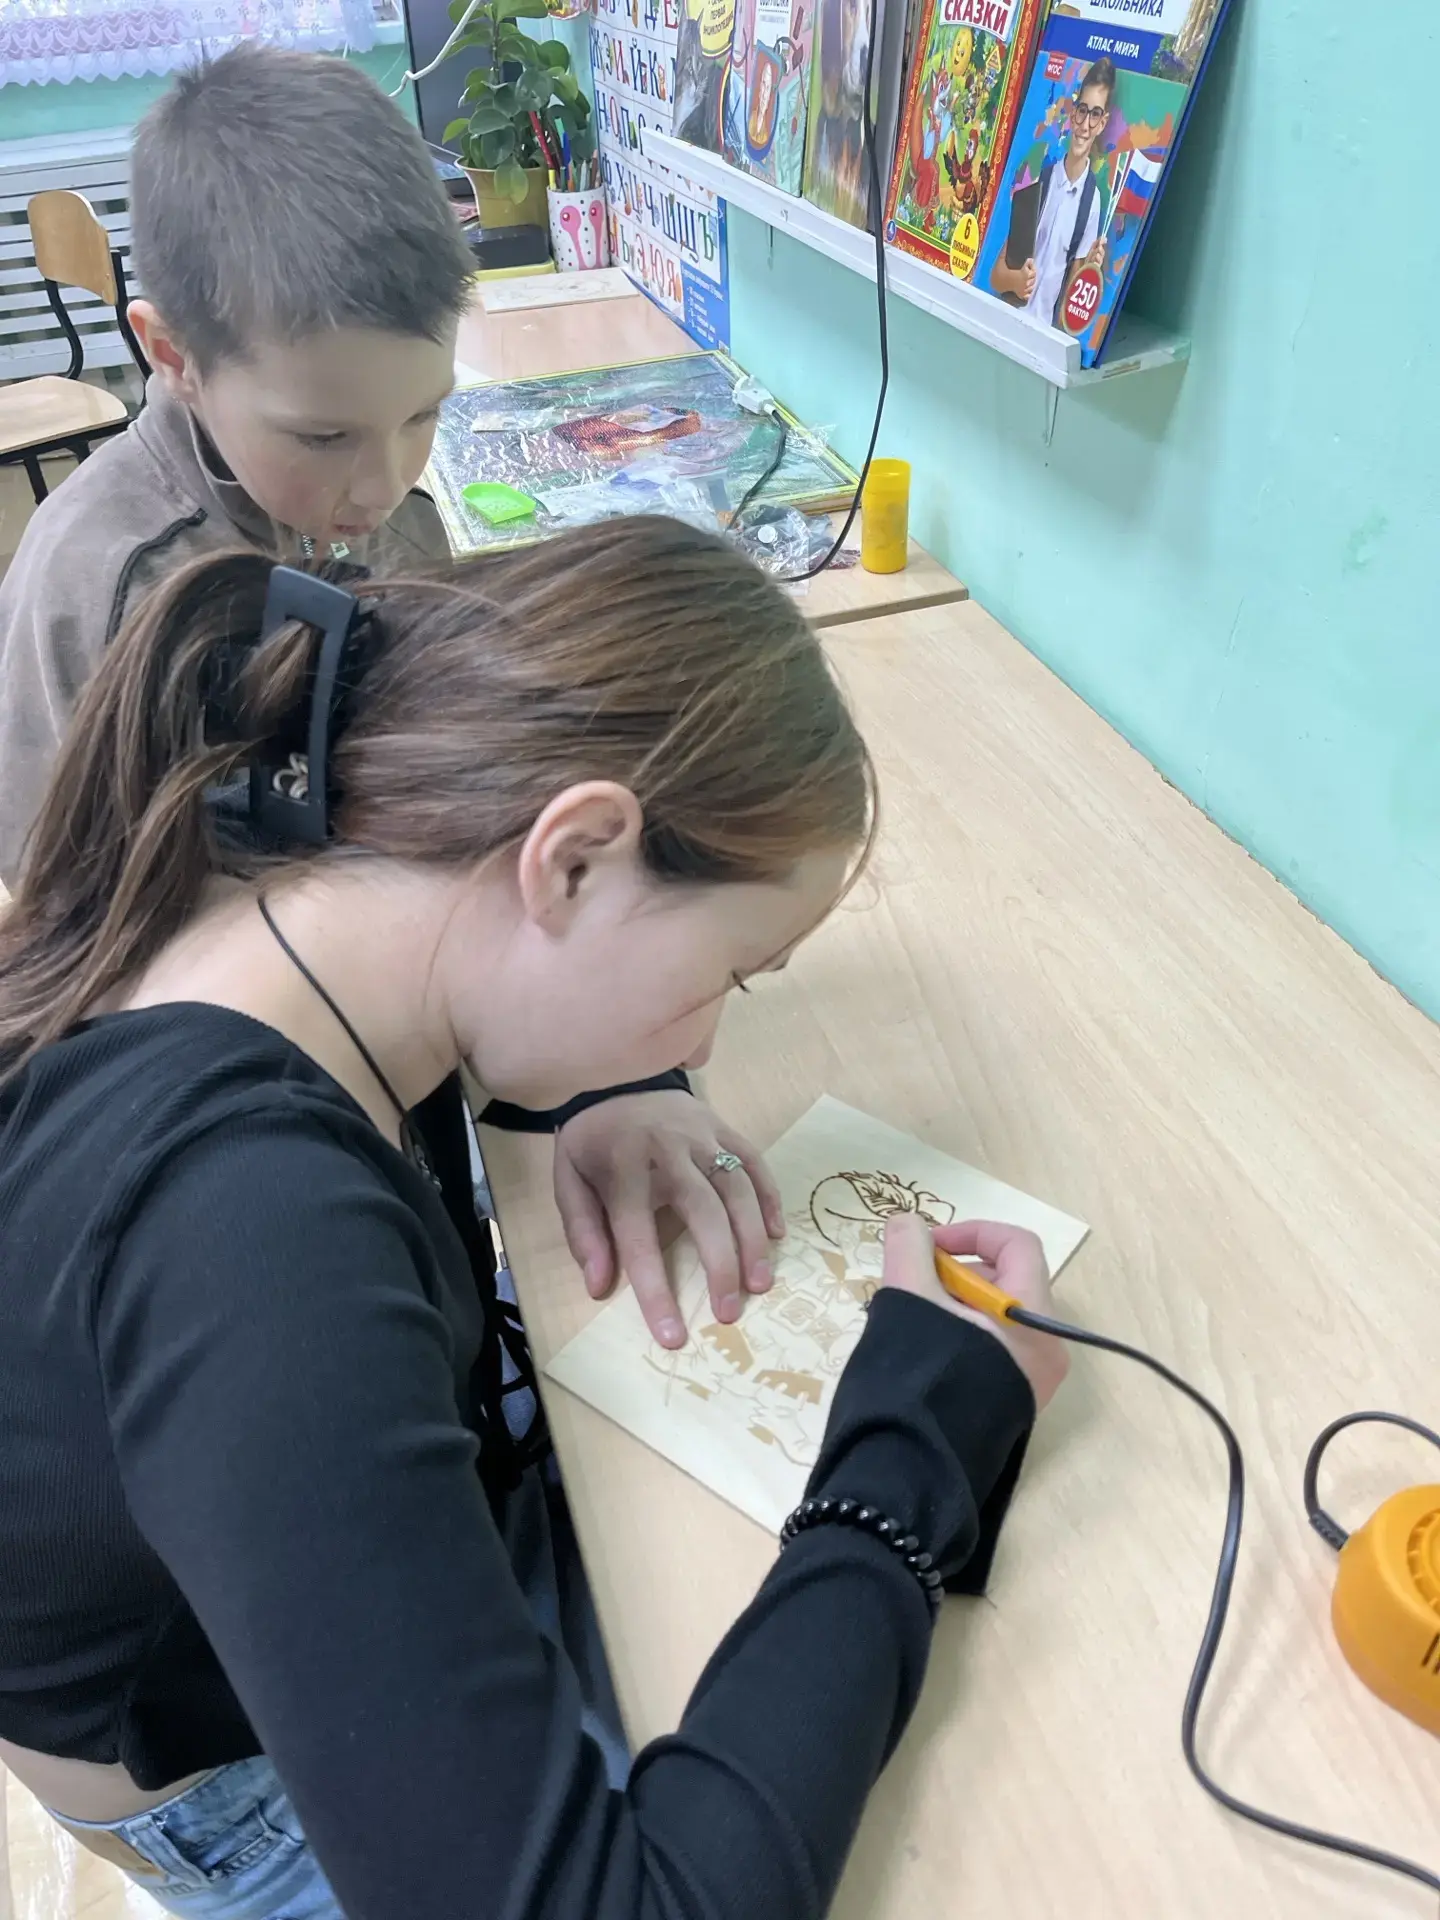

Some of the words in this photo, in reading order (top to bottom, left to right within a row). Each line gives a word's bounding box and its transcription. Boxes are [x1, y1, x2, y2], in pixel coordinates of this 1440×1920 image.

[944, 0, 1009, 35] СКАЗКИ
[1086, 35, 1114, 53] АТЛАС
[1113, 40, 1140, 59] МИРА
[612, 38, 626, 84] И
[630, 37, 646, 94] Й
[648, 50, 662, 99] К
[1047, 64, 1063, 76] ФГОС
[596, 90, 608, 133] Н
[609, 96, 620, 138] О
[620, 106, 633, 151] П
[601, 152, 612, 191] Ф
[616, 162, 627, 204] Х
[643, 182, 656, 227] Ч
[660, 192, 678, 243] Ш
[676, 202, 699, 263] Щ
[698, 212, 714, 262] Ъ
[964, 218, 972, 240] 6
[620, 224, 630, 264] Ь
[636, 233, 646, 275] Э
[650, 244, 664, 291] Ю
[667, 259, 677, 302] Я
[952, 256, 970, 272] СКАЗОК
[1070, 279, 1098, 310] 250
[1067, 304, 1090, 321] ФАКТОВ
